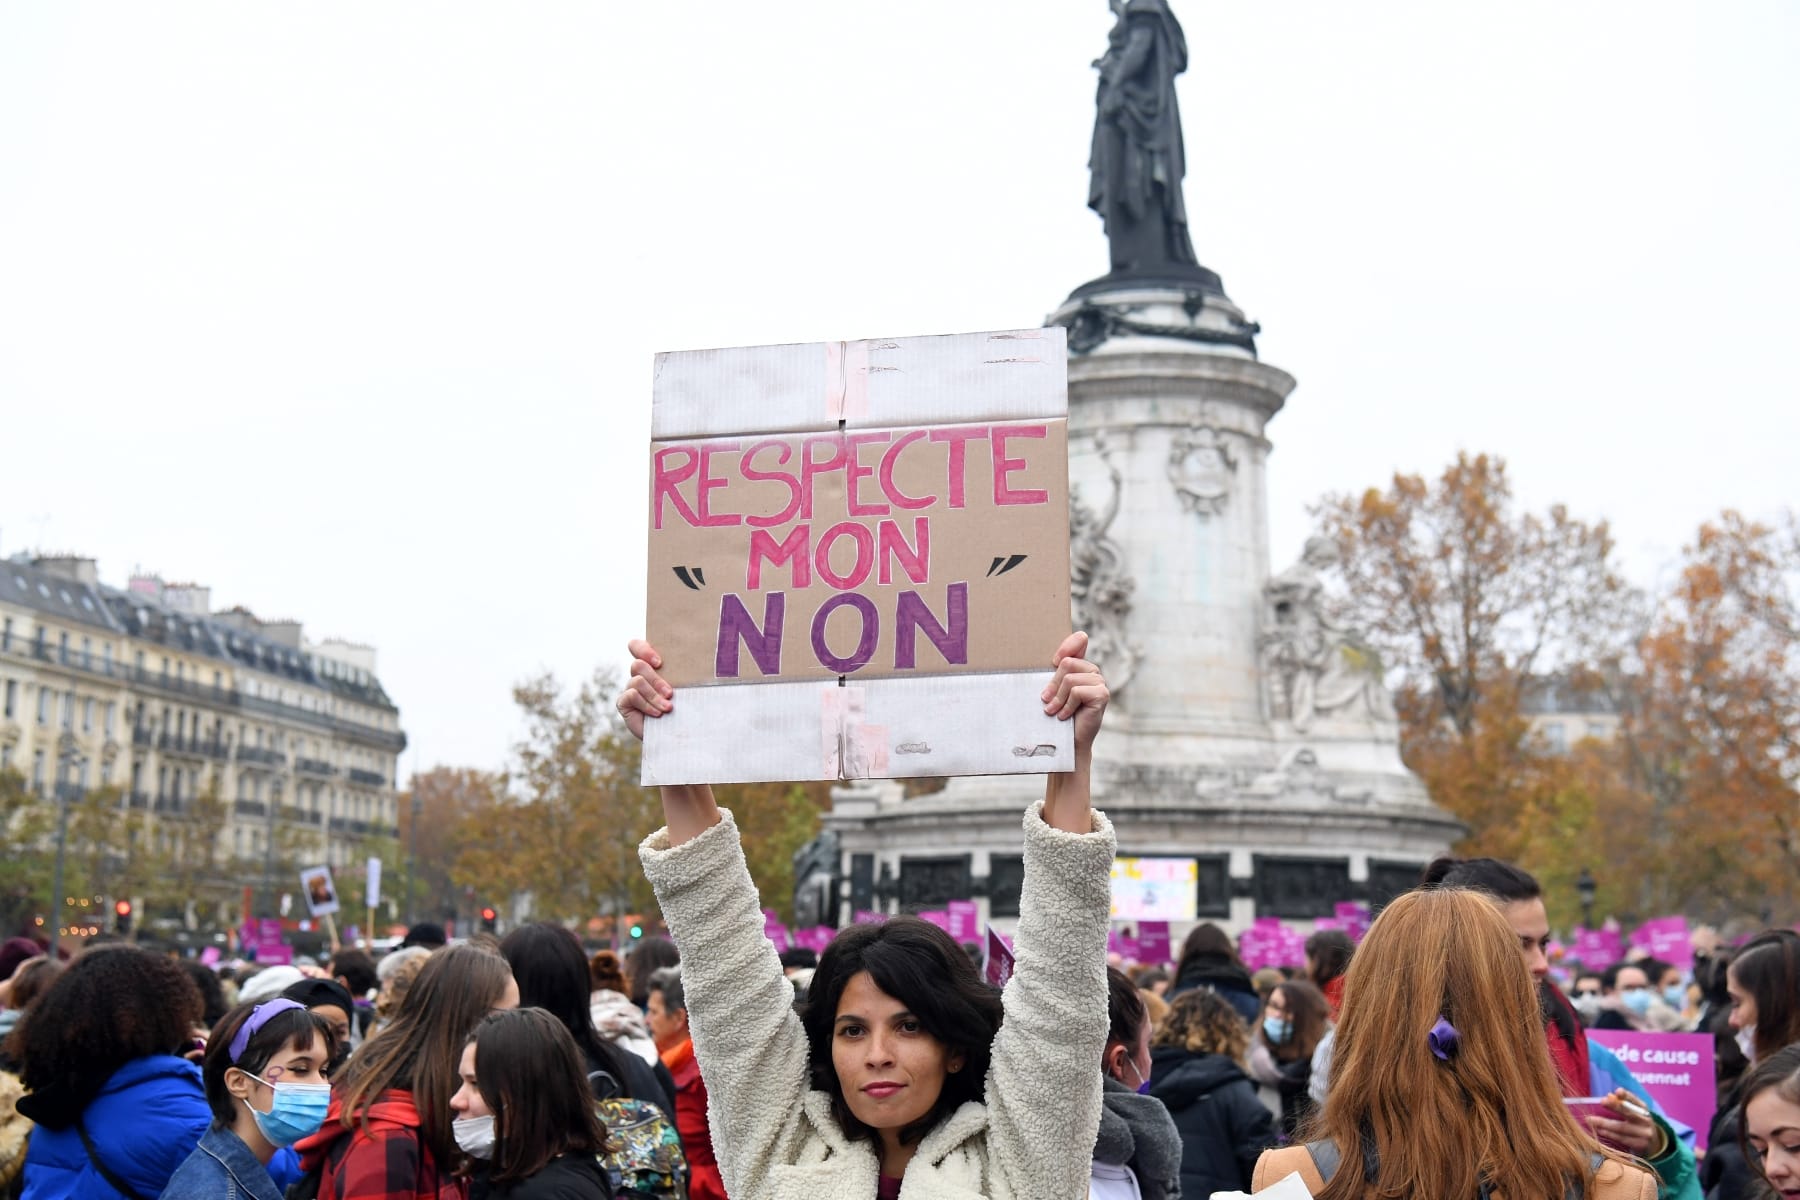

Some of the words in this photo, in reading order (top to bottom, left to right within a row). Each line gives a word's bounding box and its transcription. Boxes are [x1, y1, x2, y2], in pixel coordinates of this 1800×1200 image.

[653, 425, 1049, 530] RESPECTE
[746, 515, 931, 591] MON
[714, 581, 969, 678] NON
[1643, 1049, 1700, 1066] cause
